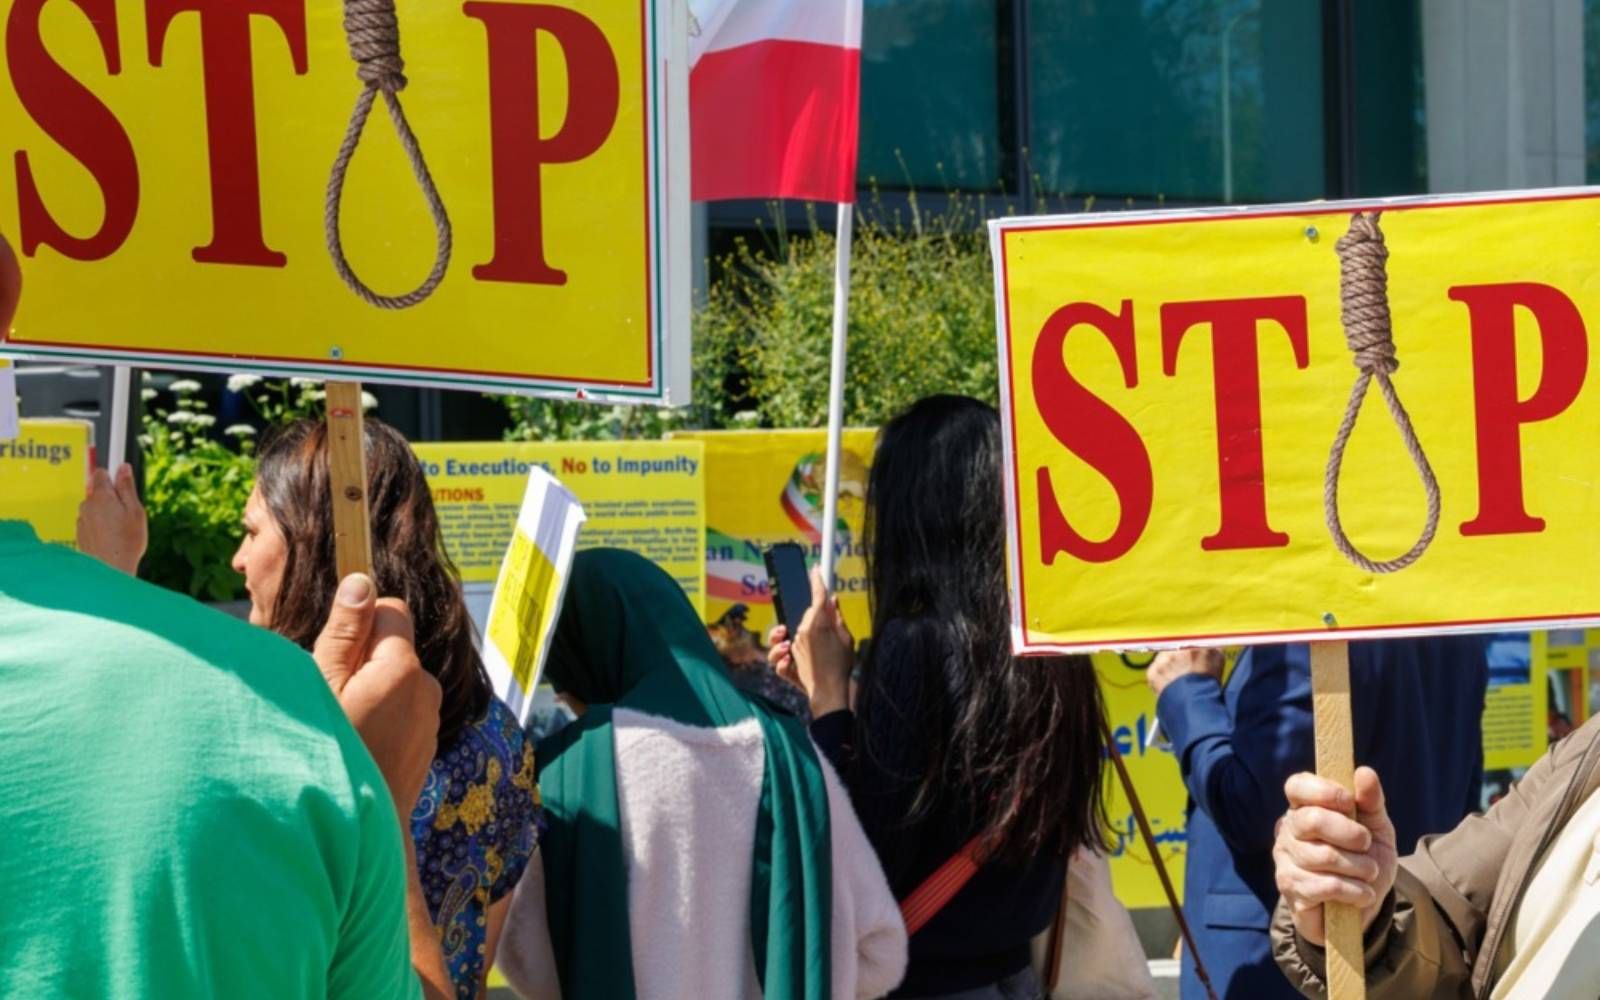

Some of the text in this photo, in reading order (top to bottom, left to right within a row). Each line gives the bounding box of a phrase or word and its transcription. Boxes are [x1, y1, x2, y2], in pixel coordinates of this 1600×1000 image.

[446, 458, 556, 476] Executios,
[562, 457, 587, 474] No
[592, 457, 611, 473] to
[617, 454, 698, 476] Impunity
